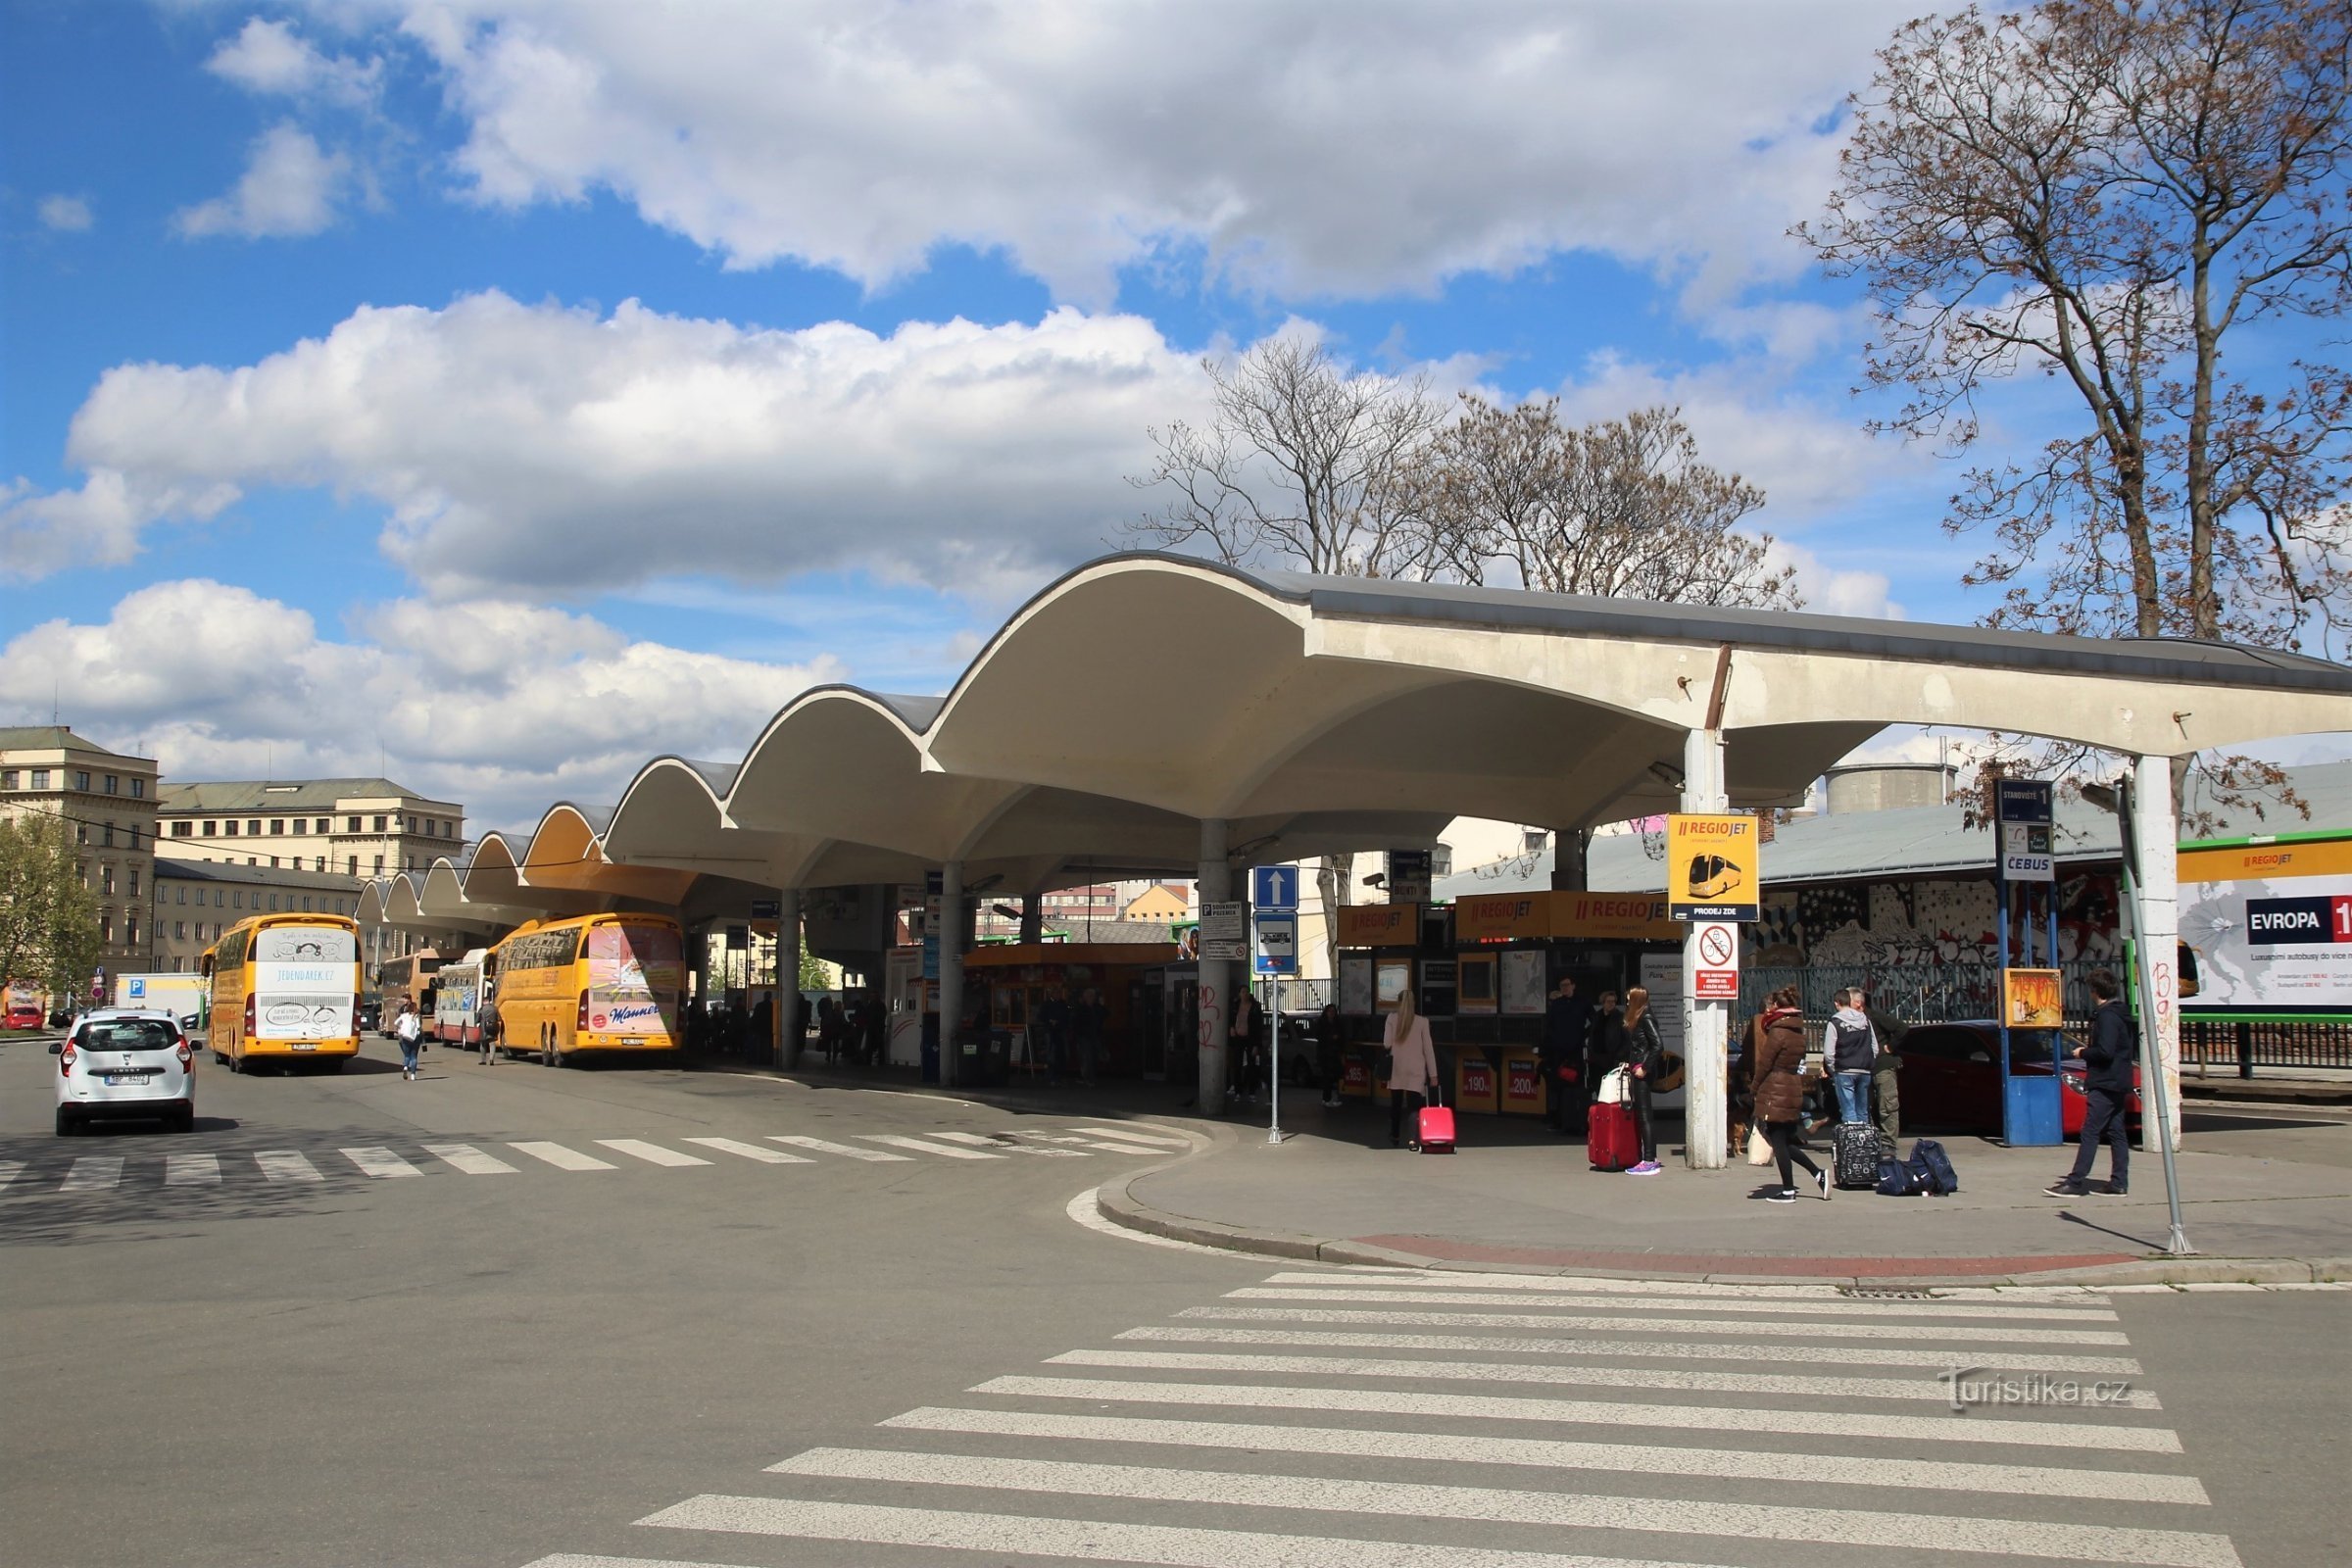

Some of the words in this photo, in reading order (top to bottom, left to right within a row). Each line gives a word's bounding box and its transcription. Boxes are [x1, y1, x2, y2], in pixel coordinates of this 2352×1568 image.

[2039, 788, 2047, 805] 1
[1690, 821, 1747, 837] REGIOJET
[1421, 856, 1429, 867] 2
[2007, 856, 2050, 871] ČEBUS
[2251, 854, 2292, 865] REGIOJET
[1481, 901, 1532, 920] REGIOJET
[1592, 900, 1668, 921] REGIOJE
[1359, 911, 1401, 930] REGIOJET
[2250, 911, 2321, 930] EVROPA
[2286, 953, 2320, 962] autobusy
[277, 969, 335, 982] JEDENDAREK.CZ
[132, 981, 141, 991] P
[609, 1004, 661, 1024] Manner
[1468, 1077, 1485, 1093] 190
[1513, 1078, 1532, 1095] 200
